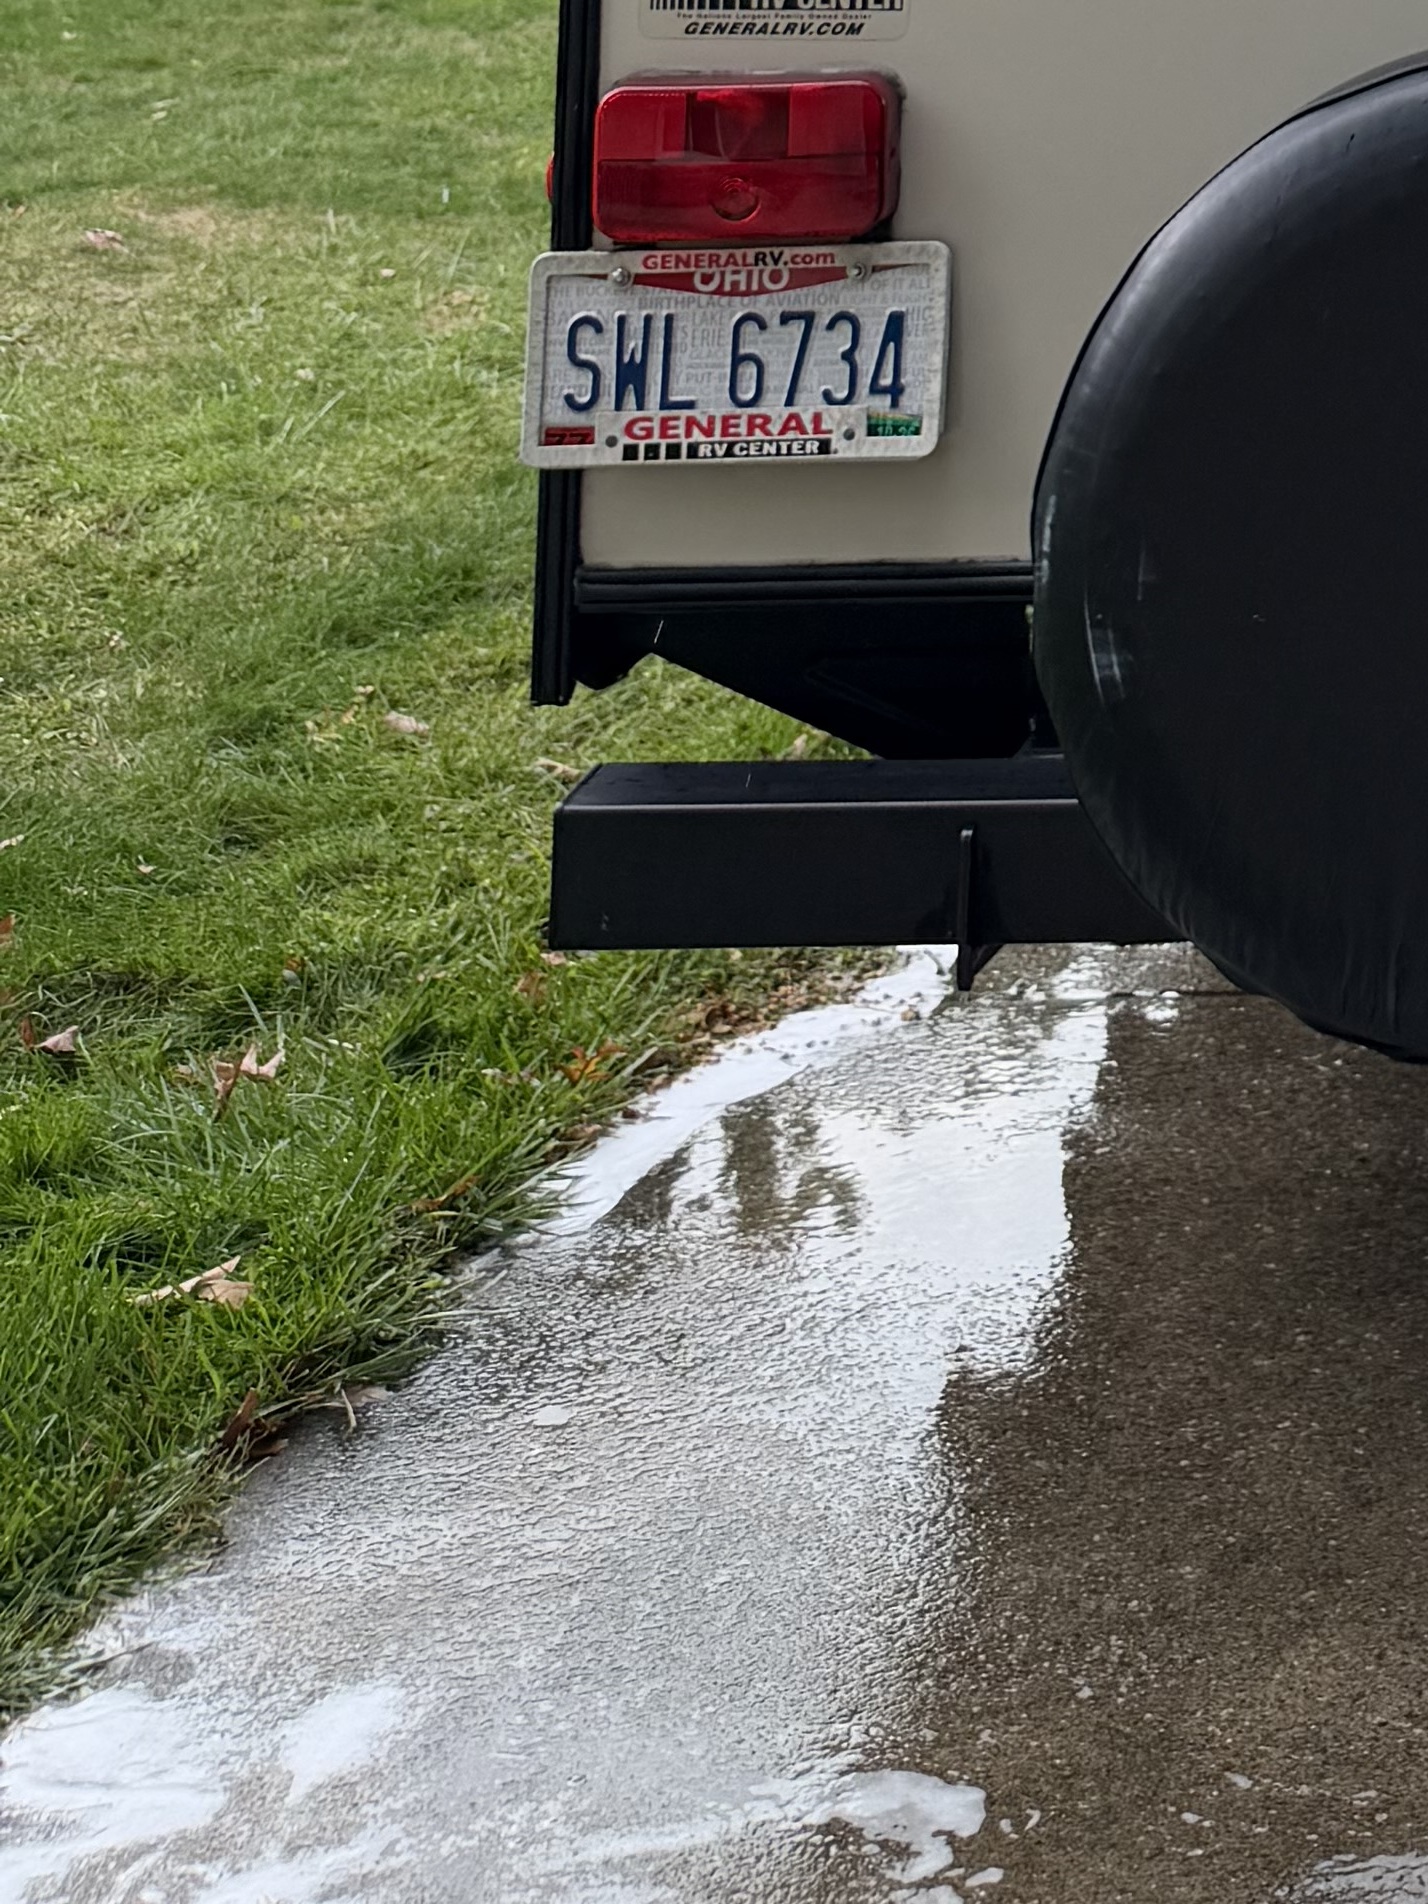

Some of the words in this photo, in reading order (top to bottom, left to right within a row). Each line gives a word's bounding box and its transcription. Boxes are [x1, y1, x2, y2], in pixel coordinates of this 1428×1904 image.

[684, 21, 865, 36] GENERALRV.COM
[642, 250, 835, 270] GENERALRV.com
[637, 295, 735, 310] BIRTHPLACE
[765, 293, 839, 307] AVIATION
[563, 310, 696, 412] SWL
[728, 309, 907, 410] 6734
[624, 411, 833, 441] GENERAL
[699, 443, 728, 458] RV
[732, 440, 820, 457] CENTER
